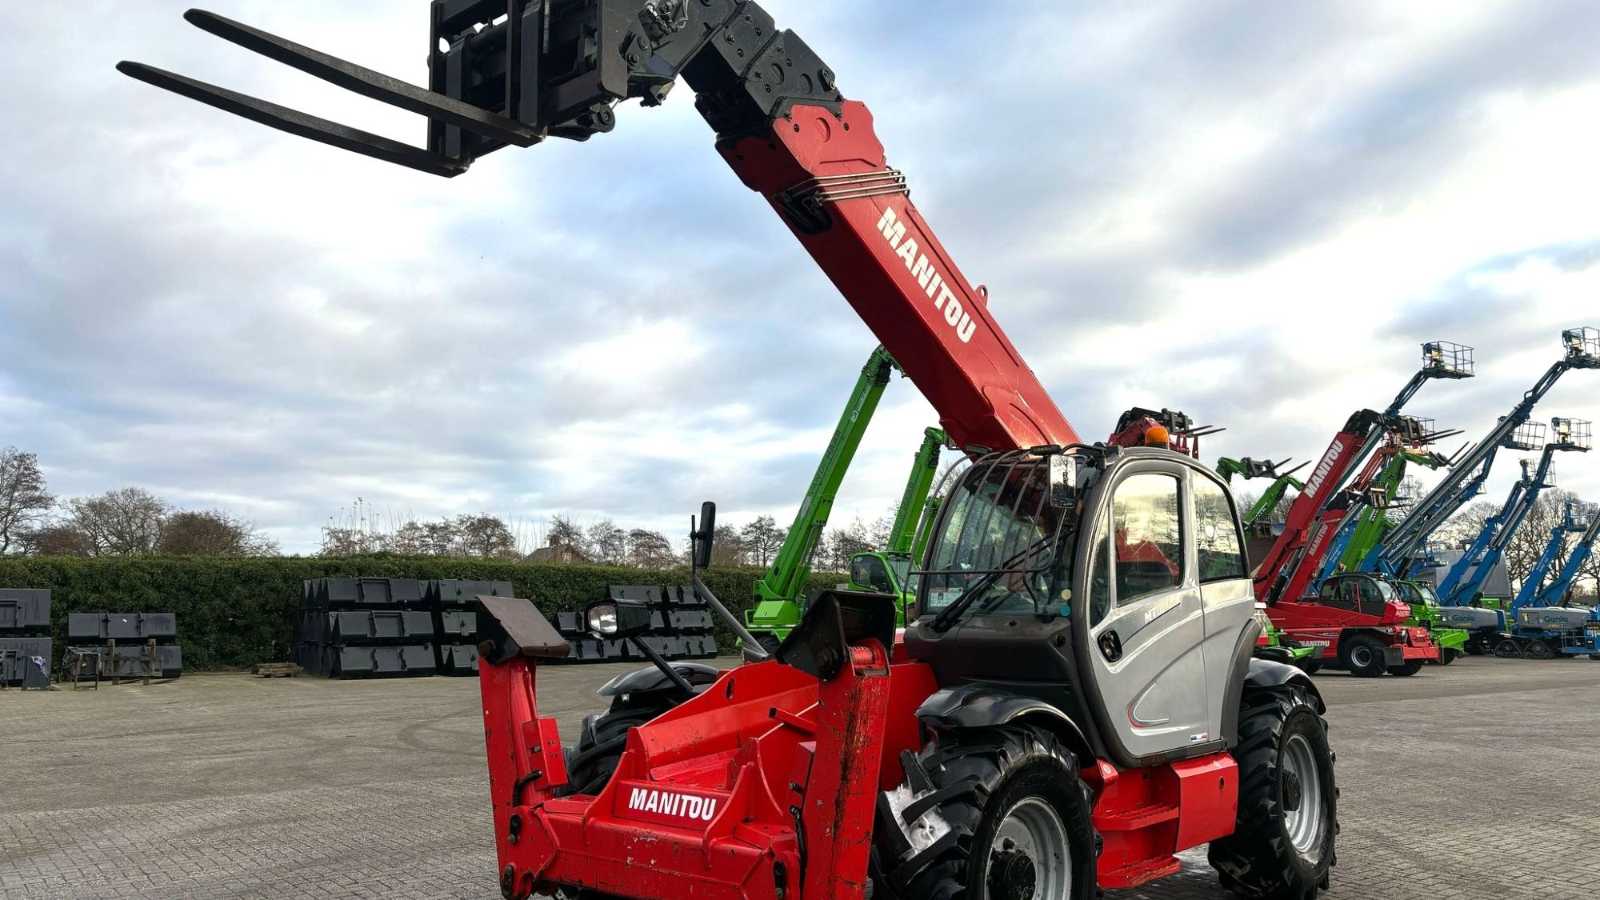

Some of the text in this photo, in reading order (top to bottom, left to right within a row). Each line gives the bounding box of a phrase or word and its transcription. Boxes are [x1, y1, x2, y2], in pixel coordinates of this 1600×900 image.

[877, 206, 976, 343] MANITOU
[1303, 439, 1344, 498] MANITOU
[628, 787, 717, 821] MANITOU
